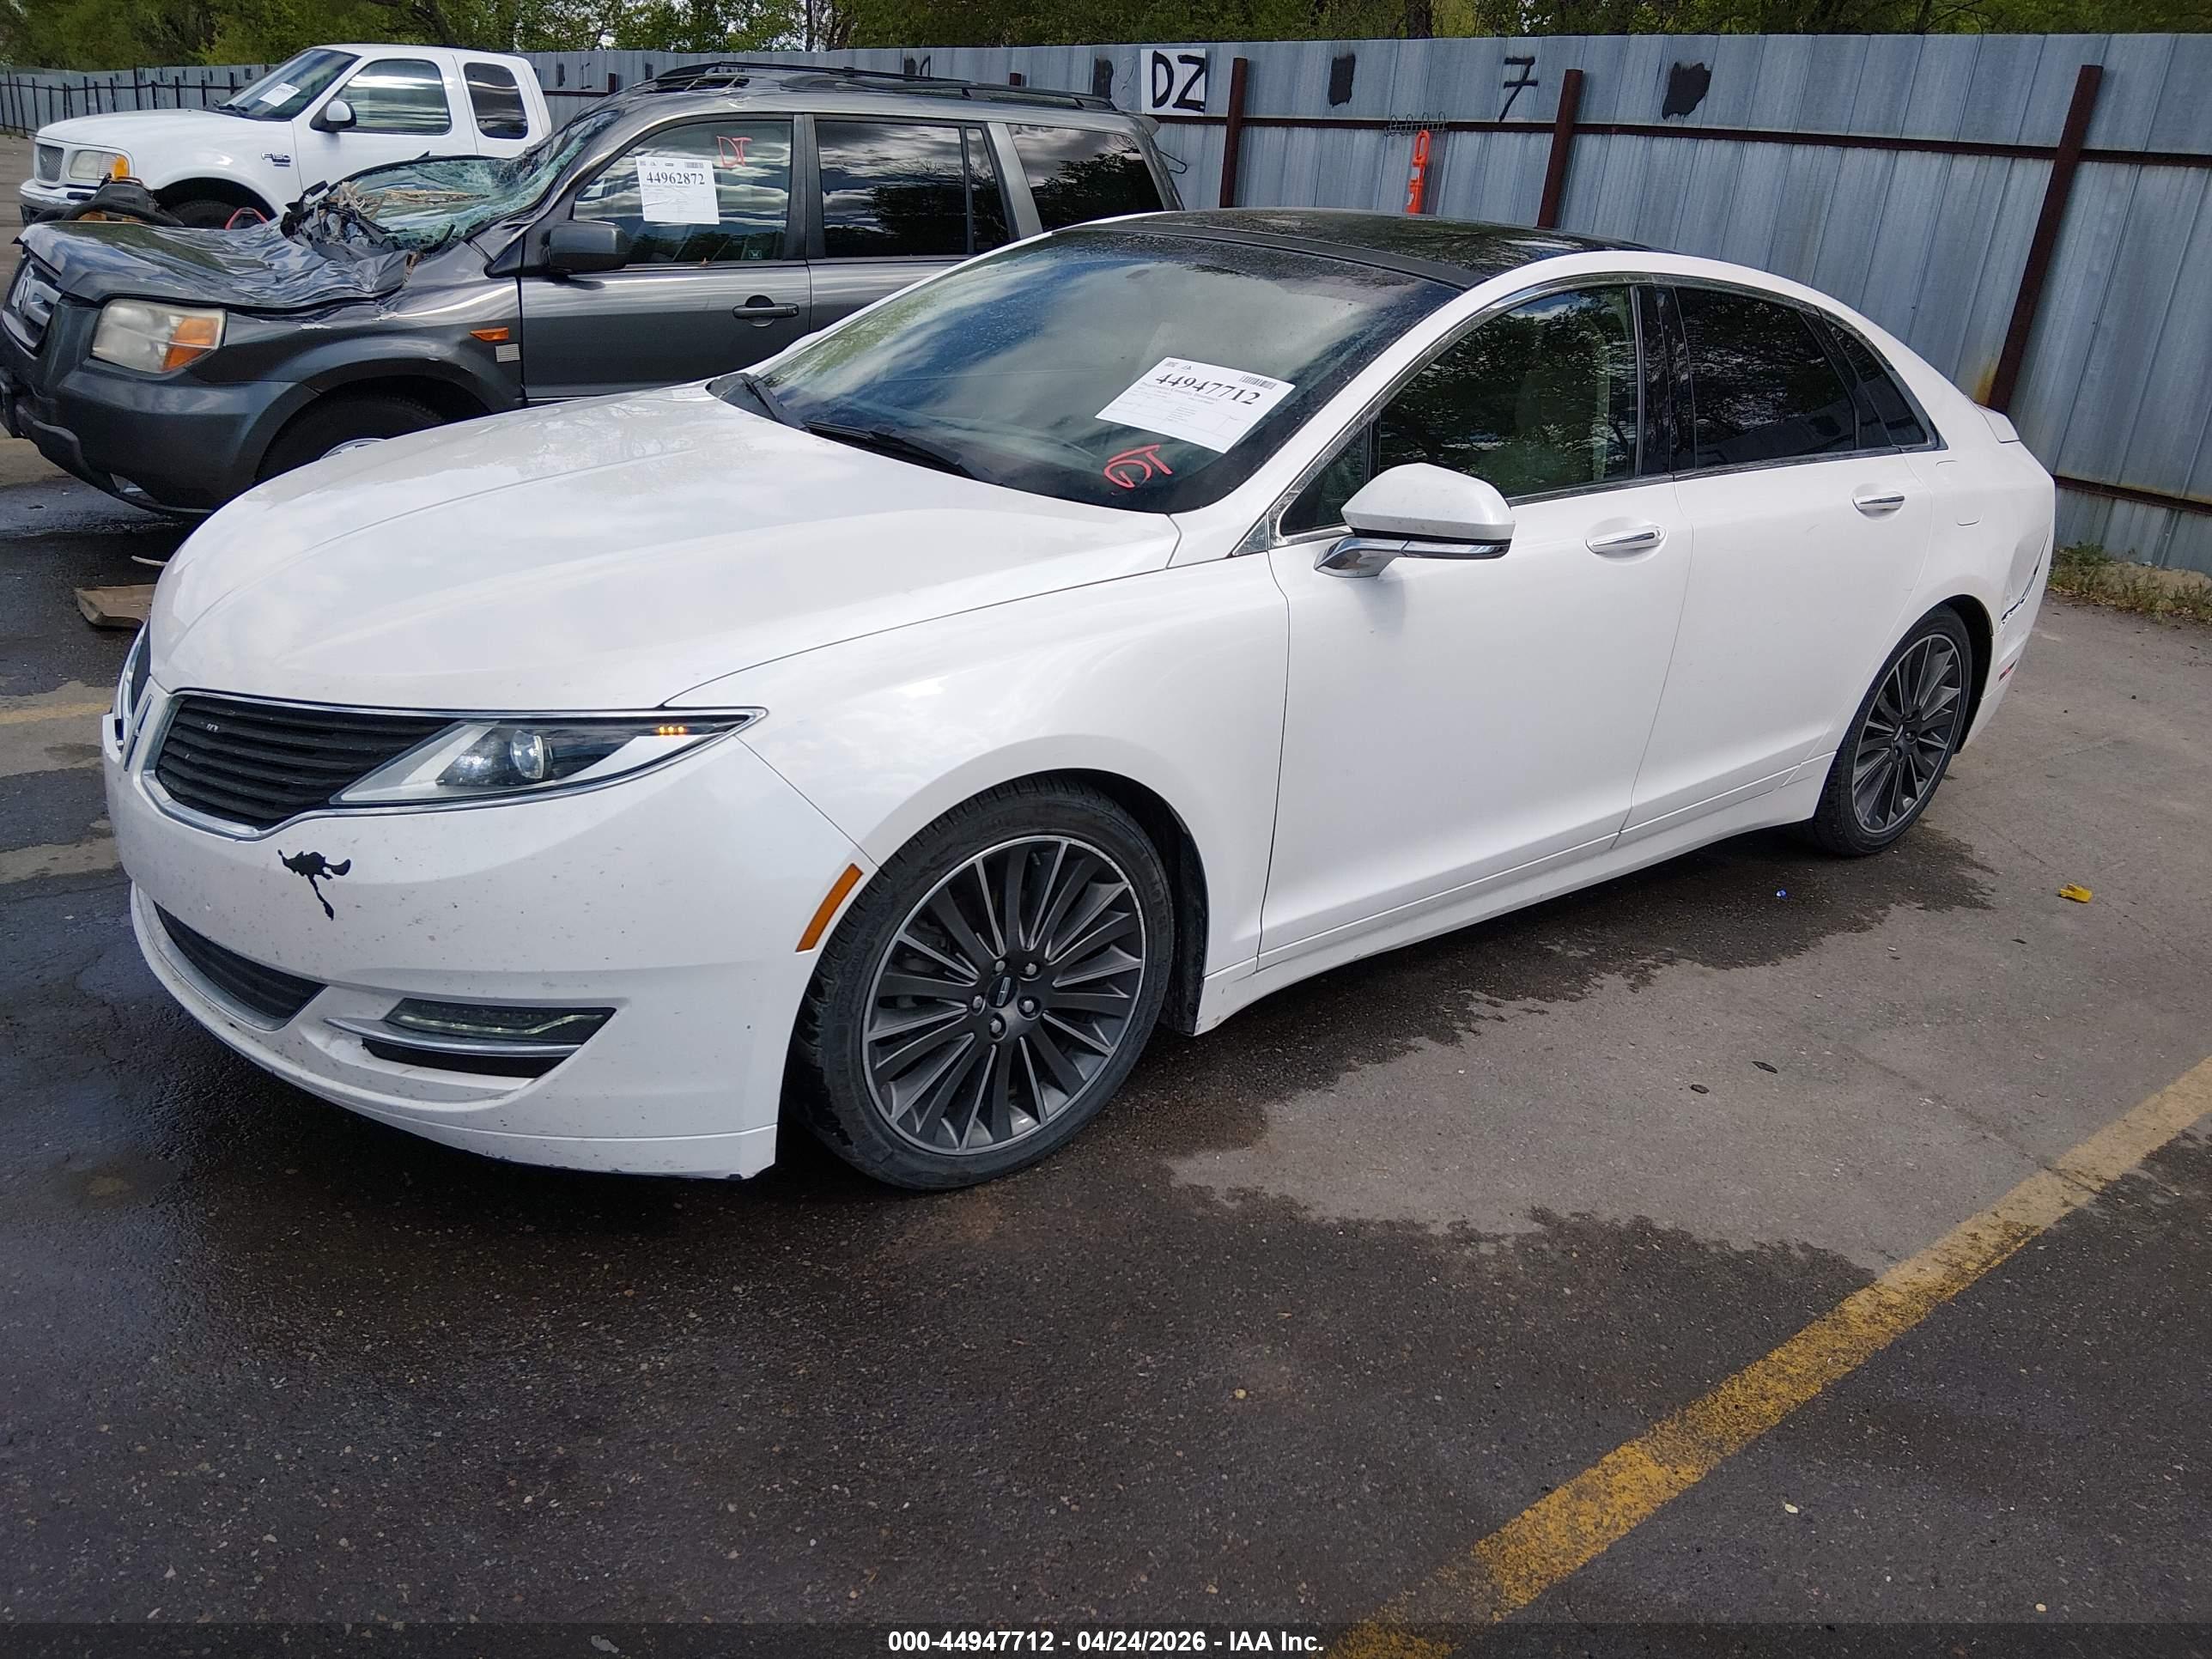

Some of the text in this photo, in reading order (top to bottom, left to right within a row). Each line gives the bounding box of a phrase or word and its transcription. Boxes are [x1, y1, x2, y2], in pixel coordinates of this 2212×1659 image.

[1152, 50, 1206, 112] DZ
[1499, 56, 1539, 122] 7
[717, 136, 753, 168] DT
[646, 171, 705, 185] 44962872
[1155, 373, 1262, 405] 44947712
